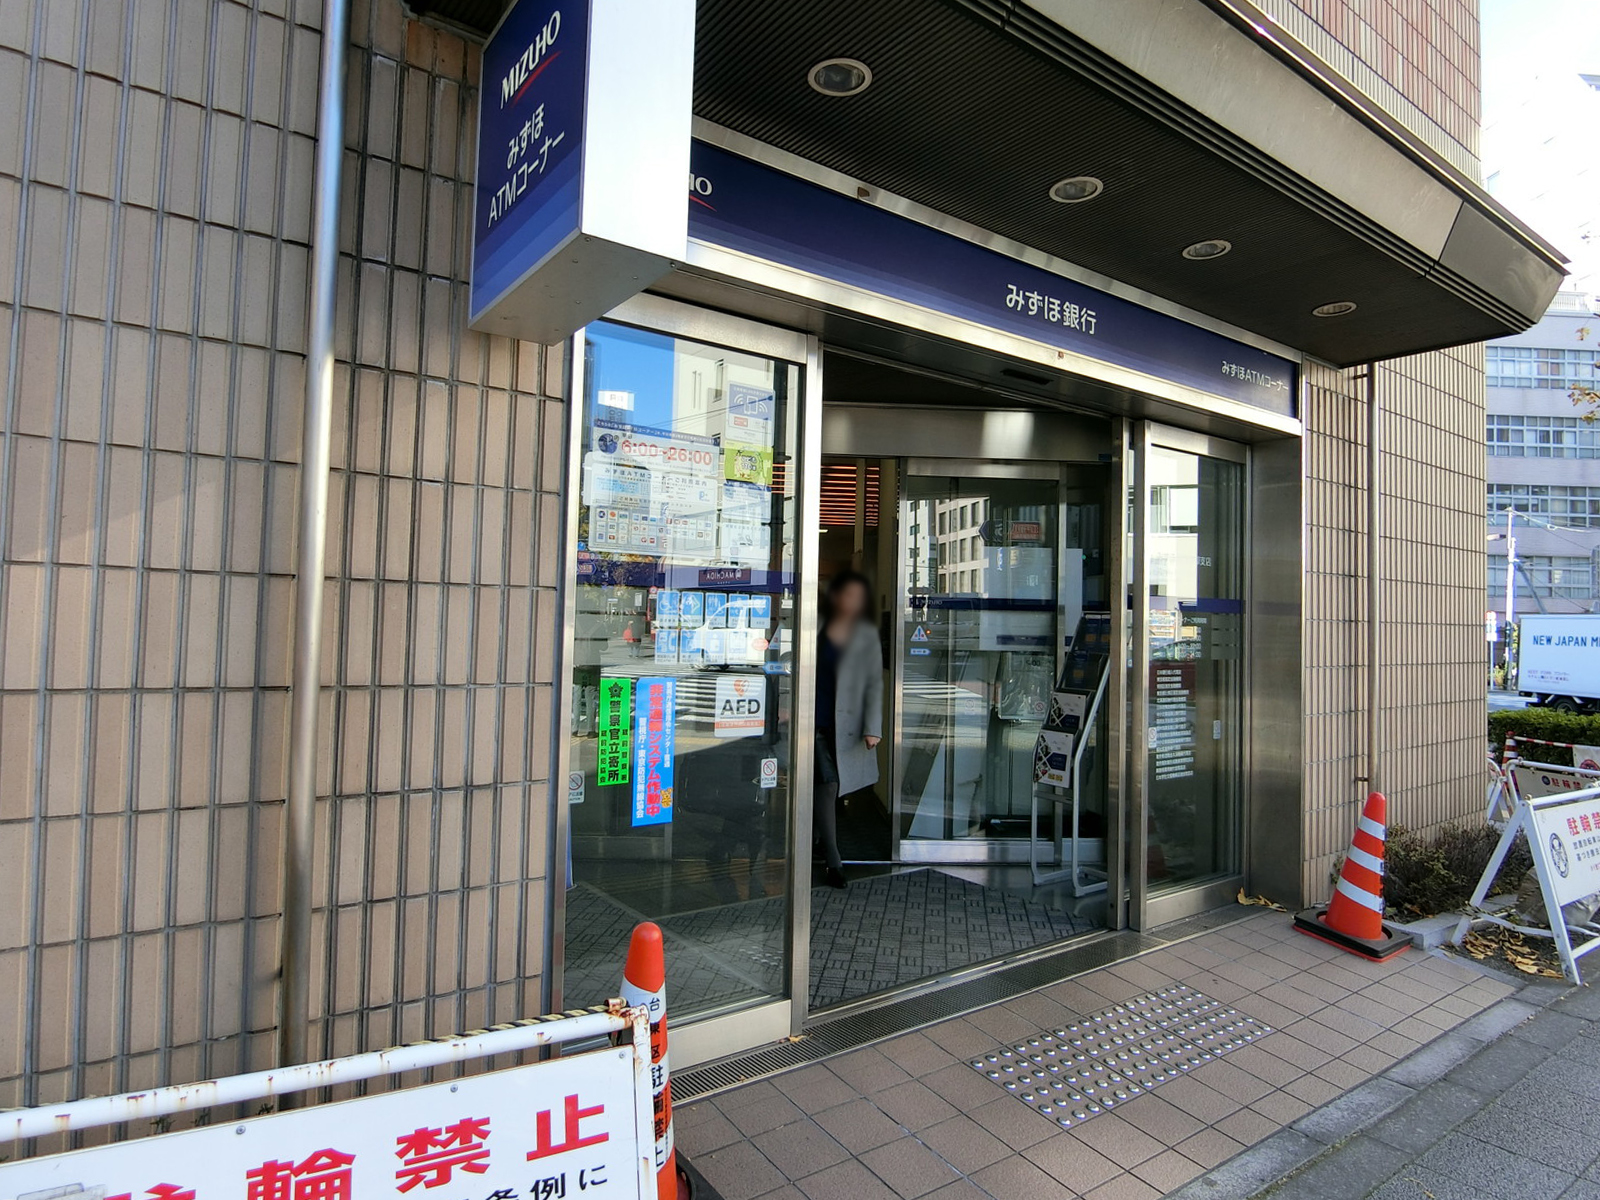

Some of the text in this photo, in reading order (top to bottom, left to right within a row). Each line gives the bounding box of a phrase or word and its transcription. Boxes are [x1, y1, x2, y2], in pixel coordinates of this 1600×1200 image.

[500, 10, 562, 109] MIZUHO
[506, 103, 545, 169] みずほ
[487, 131, 565, 228] ATMコーナー
[1006, 284, 1097, 335] みずほ銀行
[1221, 360, 1289, 391] みずほATMコーナー
[1533, 635, 1553, 646] NEW
[1555, 636, 1587, 647] JAPAN
[720, 699, 761, 715] AED
[608, 700, 621, 782] 警察官立寄所
[646, 684, 664, 817] 非常通報システム作動中
